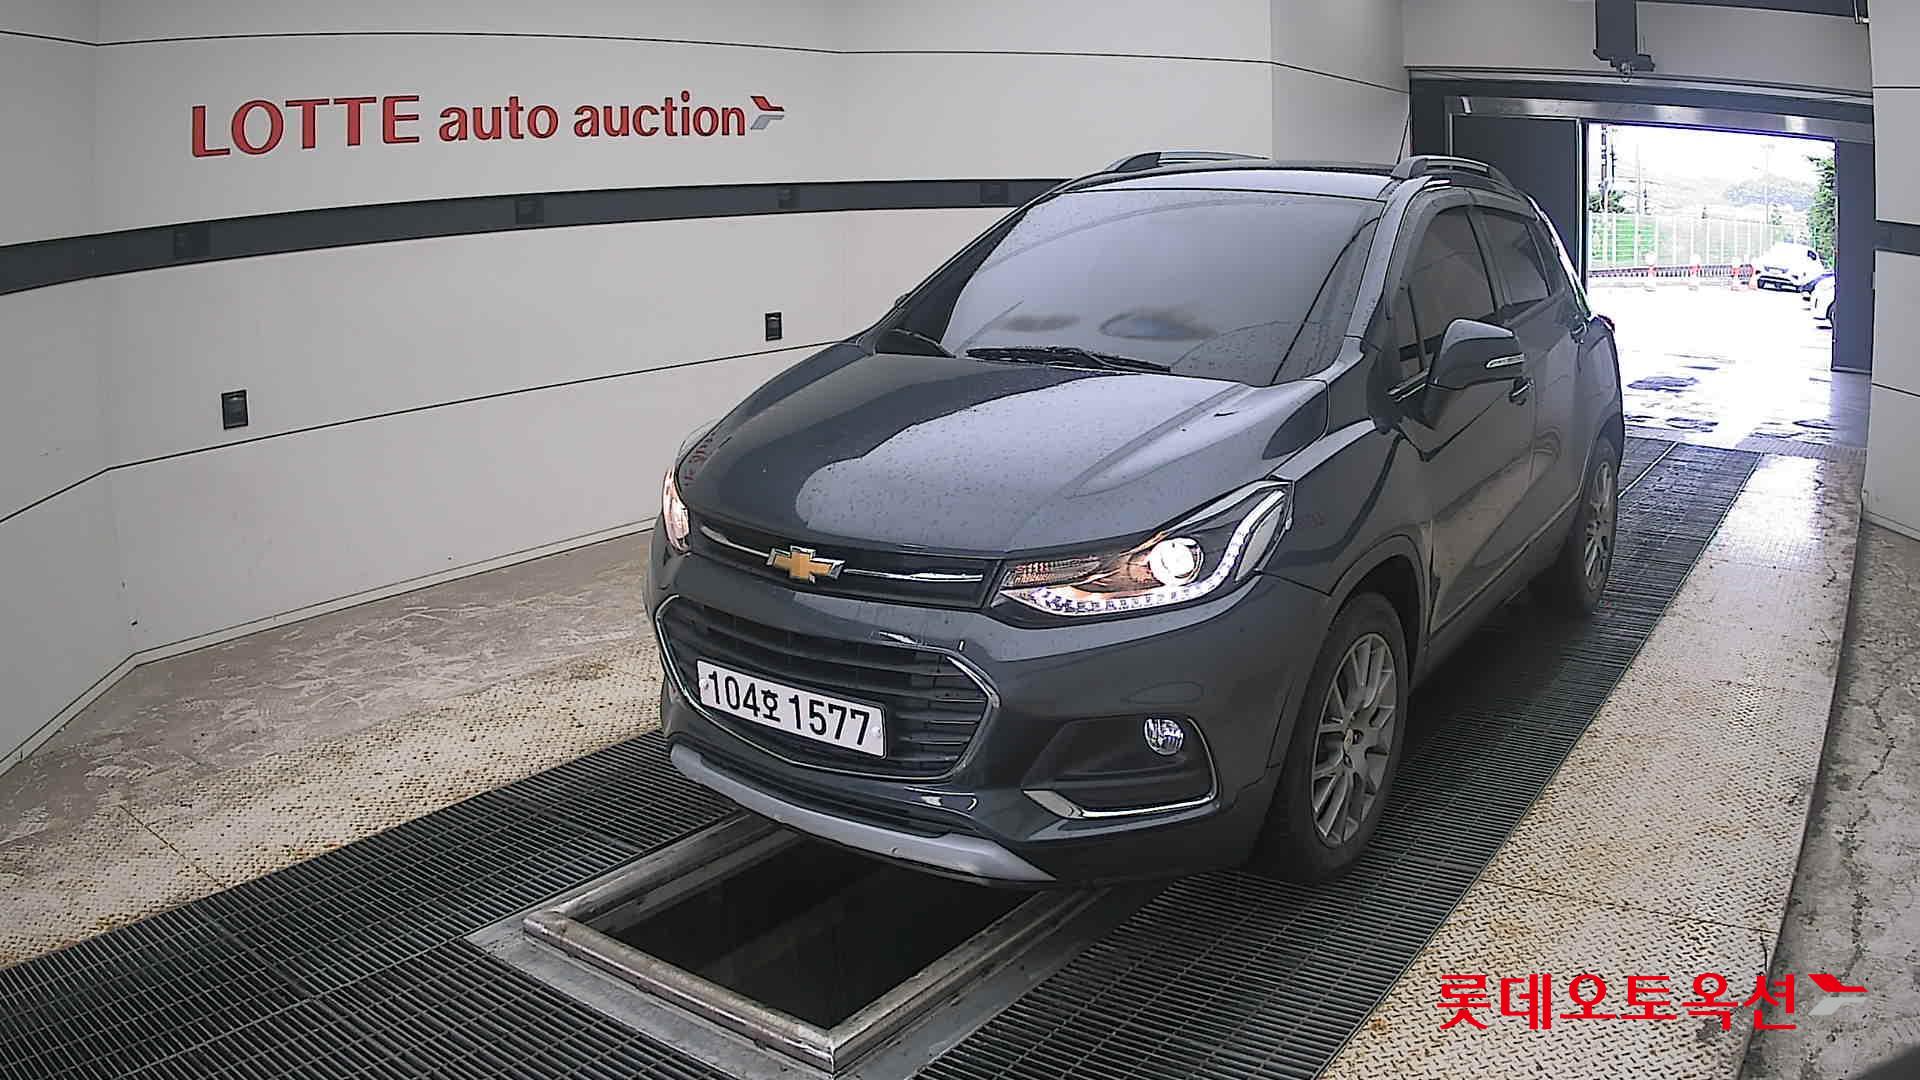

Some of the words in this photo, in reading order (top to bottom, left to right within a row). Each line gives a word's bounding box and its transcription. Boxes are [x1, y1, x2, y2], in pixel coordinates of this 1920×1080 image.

[192, 95, 420, 157] LOTTE
[439, 96, 559, 141] auto
[573, 90, 746, 137] auction
[708, 671, 781, 723] 104호
[788, 694, 870, 746] 1577
